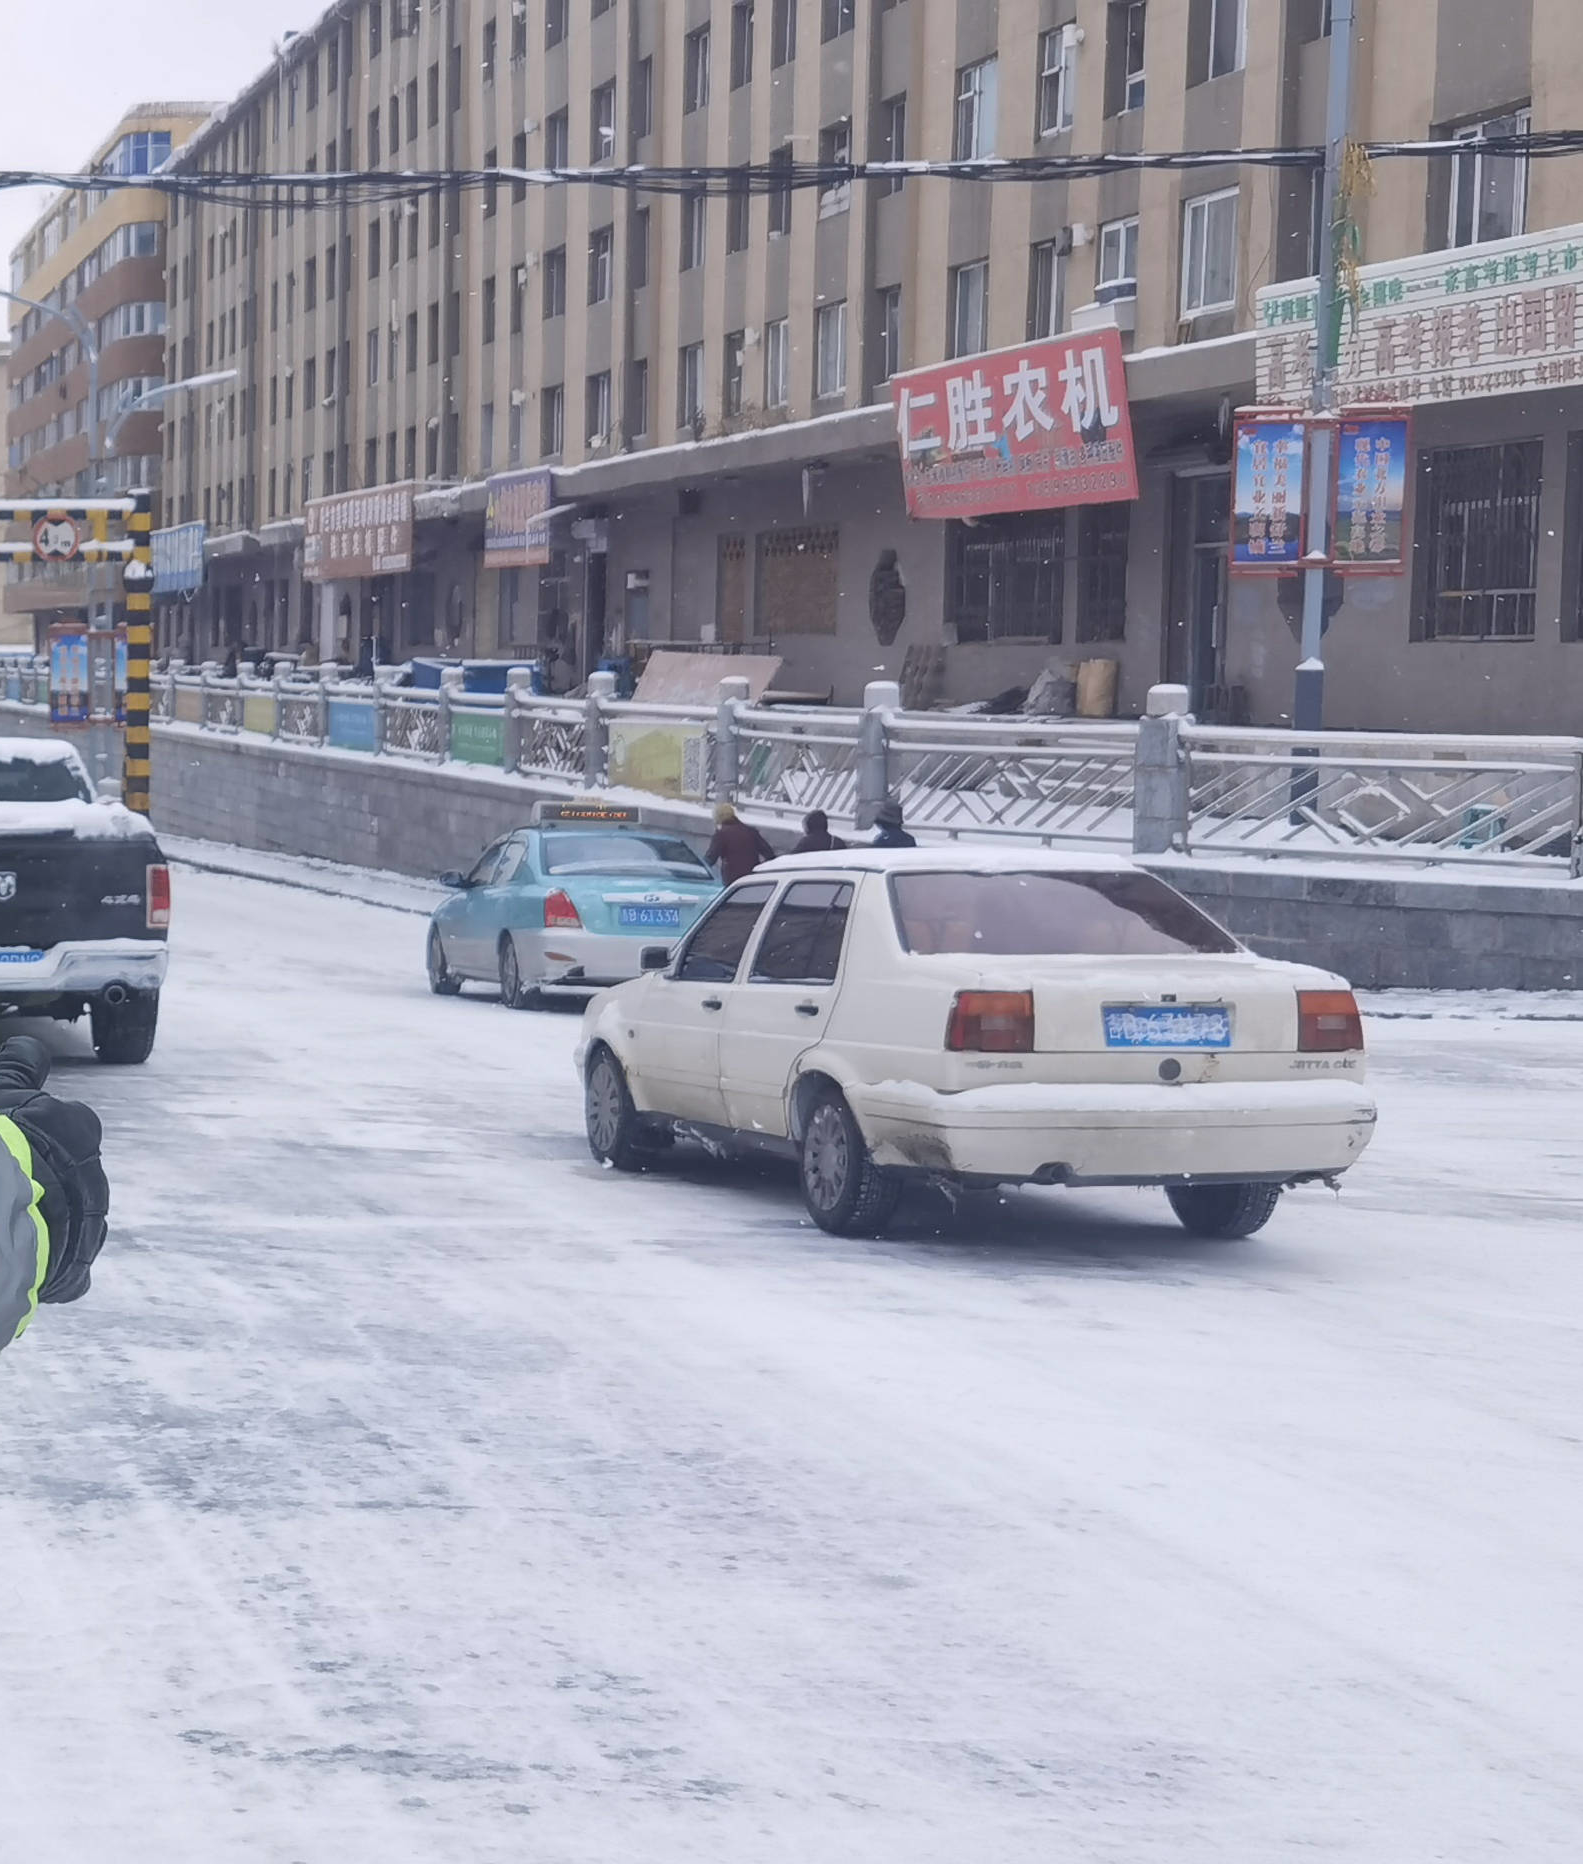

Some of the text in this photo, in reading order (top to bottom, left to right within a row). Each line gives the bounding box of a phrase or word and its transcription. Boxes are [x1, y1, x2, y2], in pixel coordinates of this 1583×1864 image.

[897, 347, 1119, 460] 仁胜农机
[1289, 1060, 1330, 1070] JETTA
